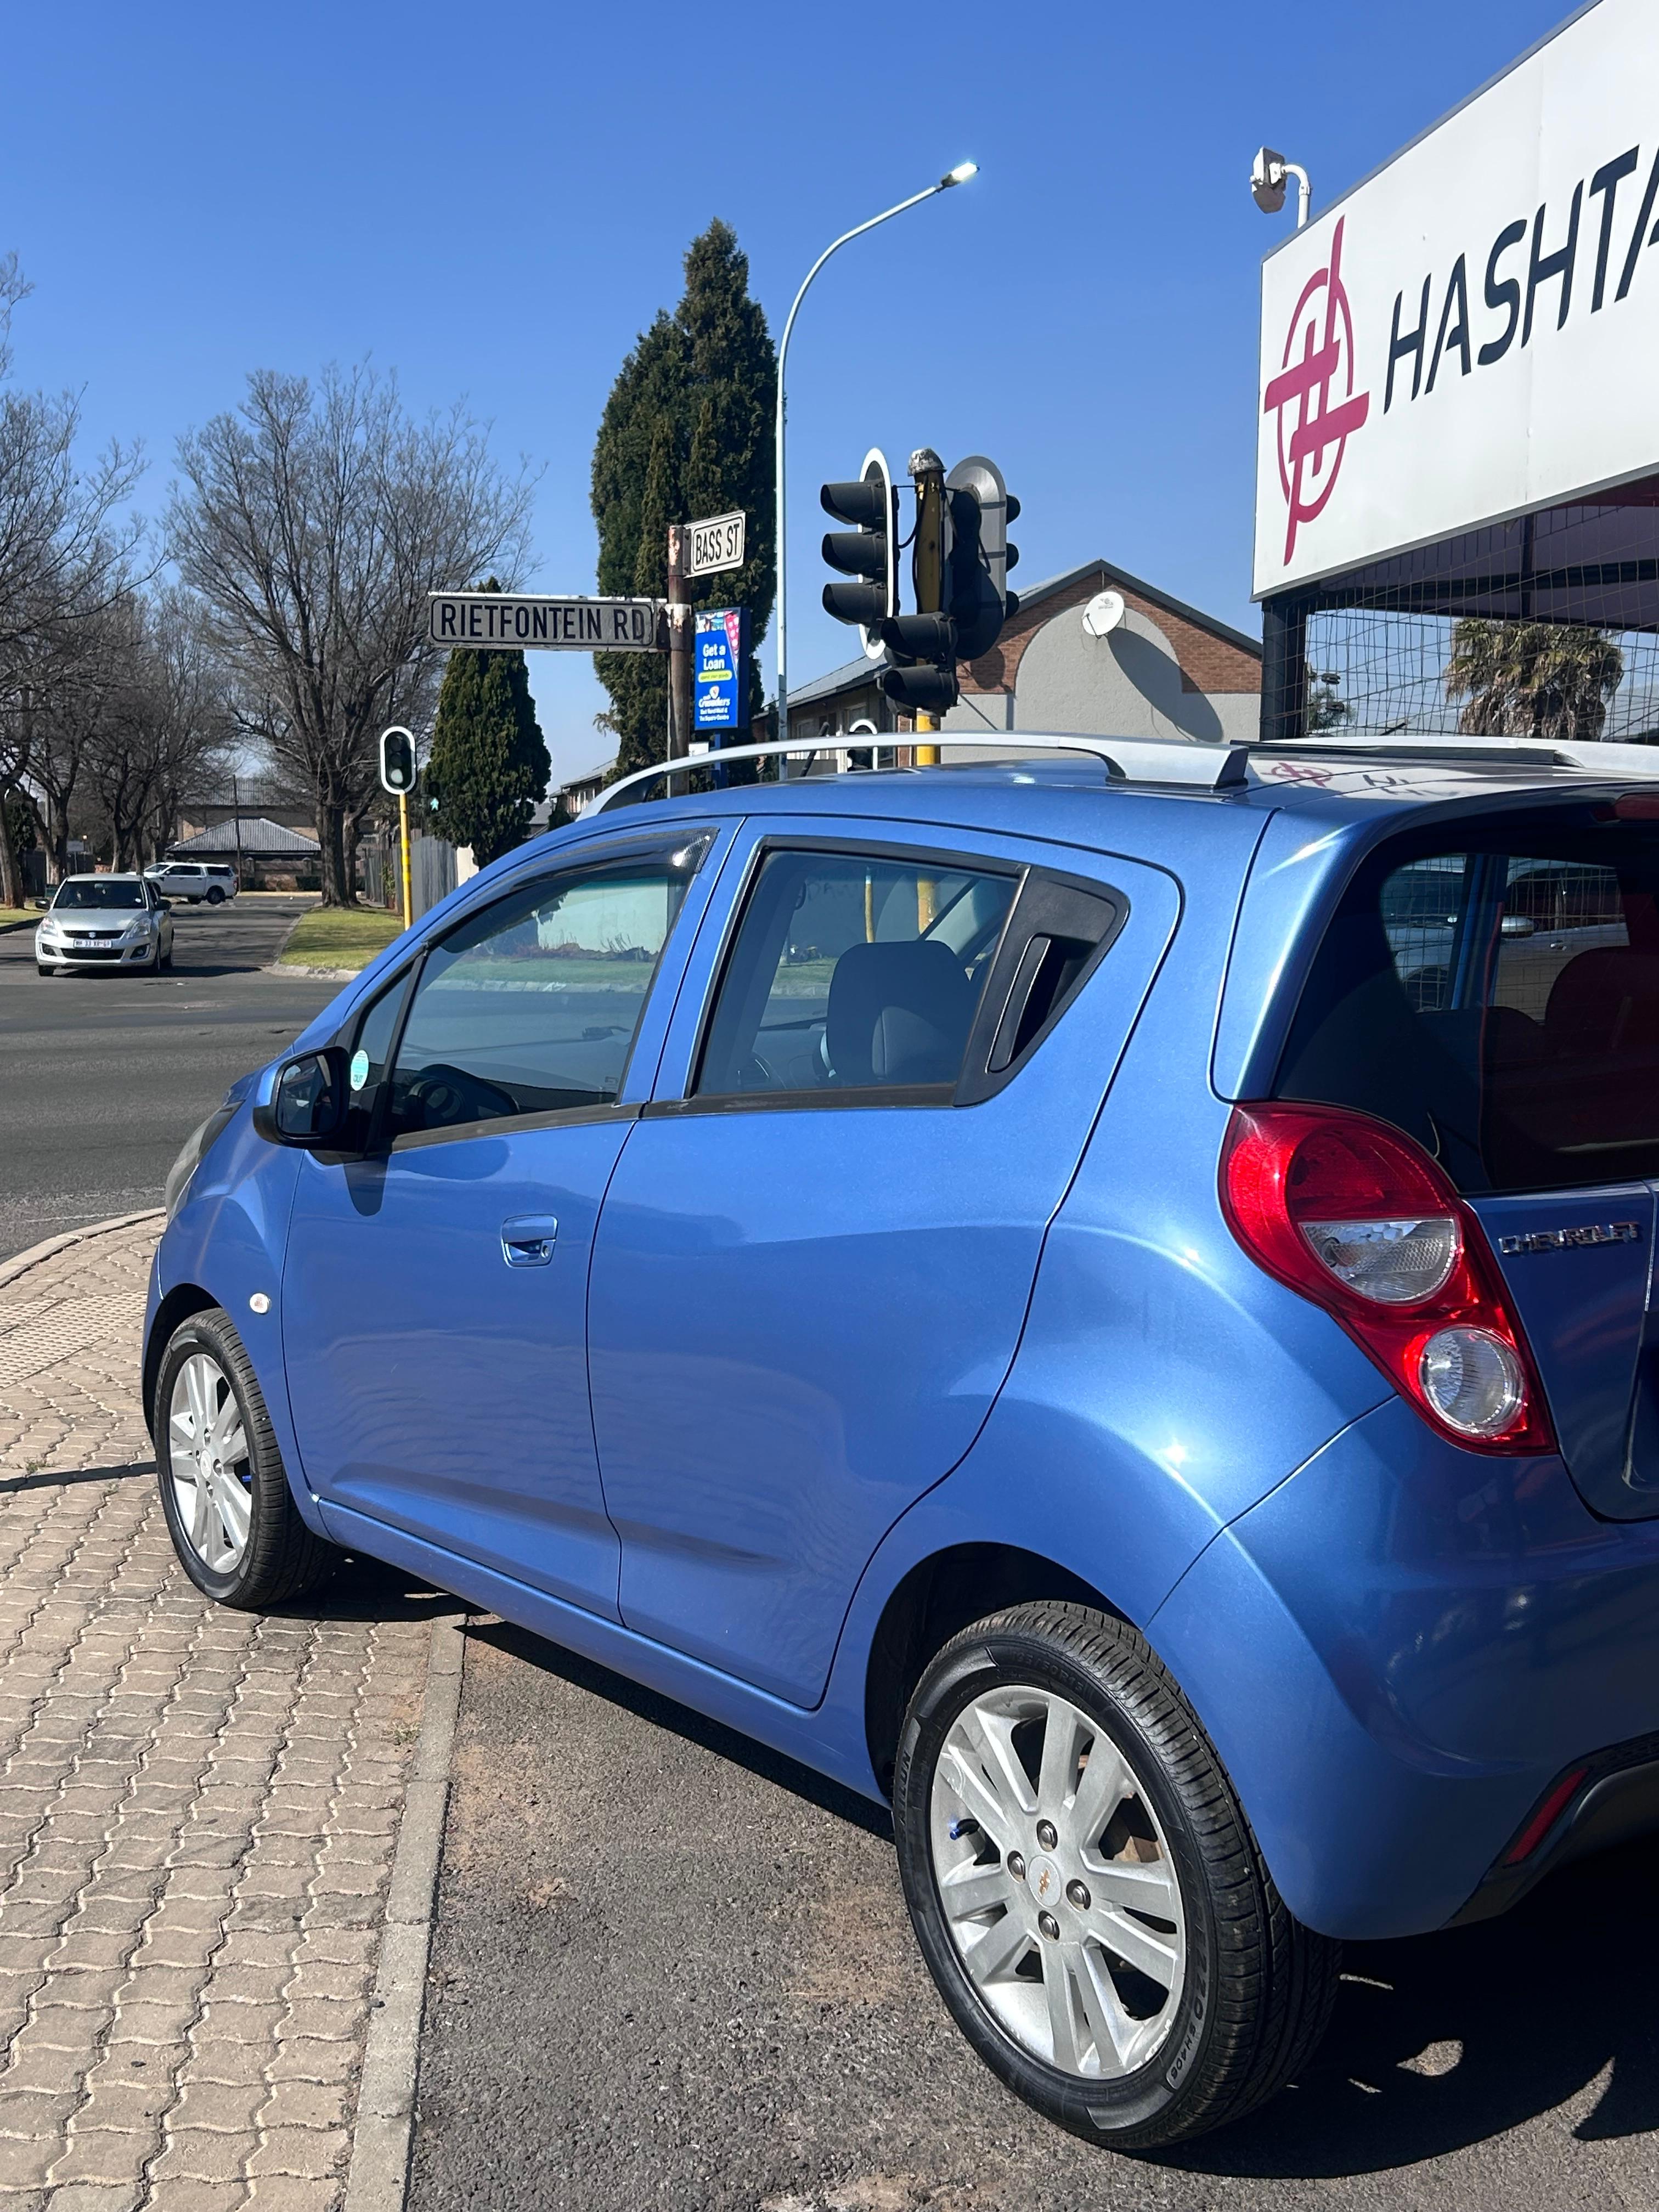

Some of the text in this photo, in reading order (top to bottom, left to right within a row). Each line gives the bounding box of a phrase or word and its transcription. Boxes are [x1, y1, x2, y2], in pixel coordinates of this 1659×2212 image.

[696, 523, 740, 566] BASS ST
[441, 603, 645, 641] RIETFONTEIN RD
[703, 644, 726, 657] Get a
[703, 658, 725, 670] Loan
[1498, 1219, 1640, 1254] CHEVROLET
